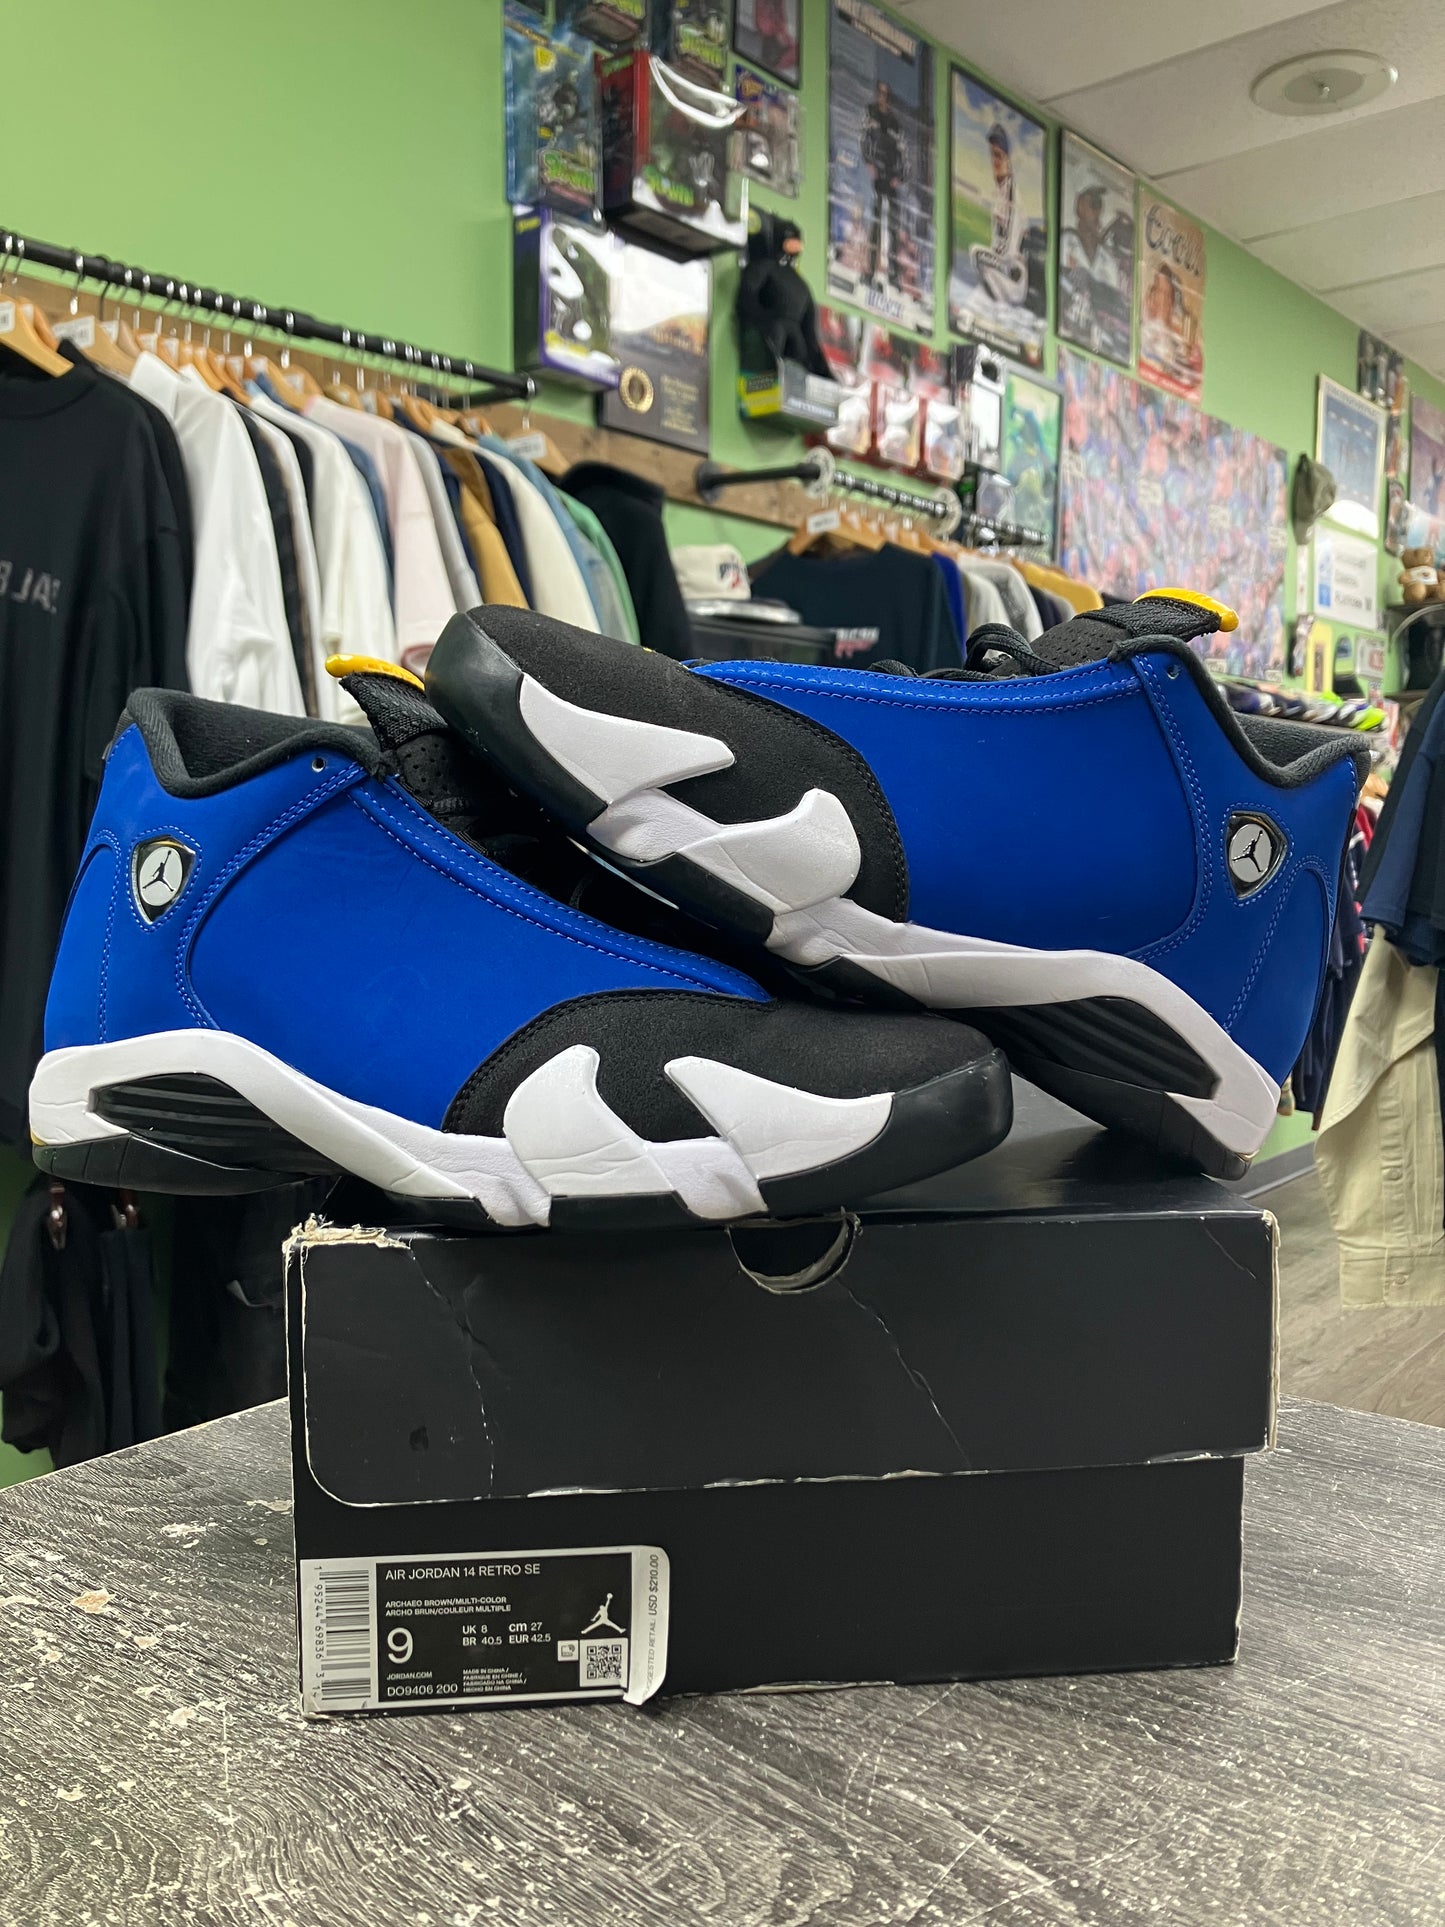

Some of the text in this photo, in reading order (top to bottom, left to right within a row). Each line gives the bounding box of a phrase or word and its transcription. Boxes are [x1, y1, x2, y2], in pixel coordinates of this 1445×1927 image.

[385, 1563, 541, 1581] AIR JORDAN 14 RETRO SE
[648, 1554, 660, 1592] $210.00
[385, 1596, 507, 1608] ARCHAEO BROWN/MULTI-COLOR
[647, 1594, 659, 1615] USD
[385, 1604, 512, 1617] ARCHO BRUN/COULEUR MULTIPLE
[462, 1621, 543, 1635] UK 8 cm 27
[387, 1627, 414, 1664] 9
[462, 1633, 551, 1646] BR 40.5 EUR 42.5
[386, 1671, 433, 1681] JORDAN.COM
[436, 1683, 458, 1694] 200
